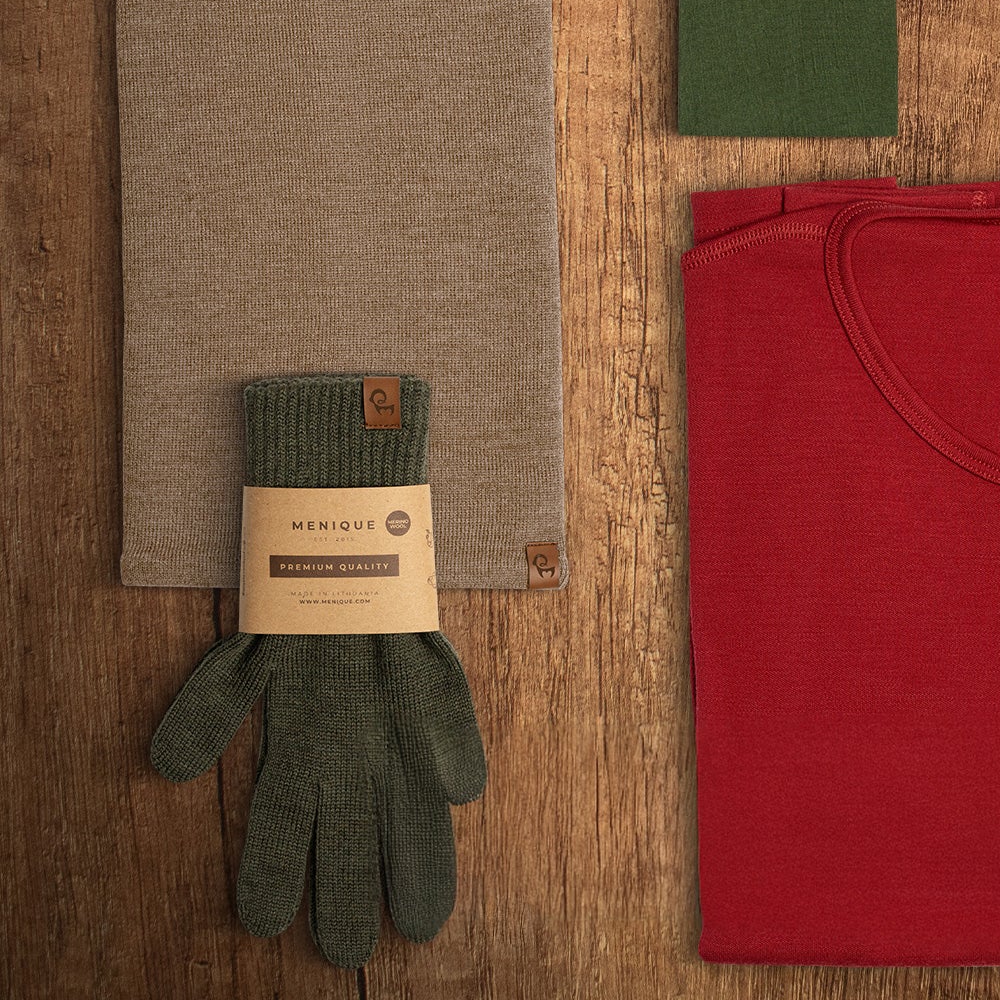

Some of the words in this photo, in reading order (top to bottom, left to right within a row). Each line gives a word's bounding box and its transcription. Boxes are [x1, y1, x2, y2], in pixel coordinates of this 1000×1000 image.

[291, 519, 376, 532] MENIQUE
[280, 562, 334, 571] PREMIUM
[339, 562, 390, 572] QUALITY
